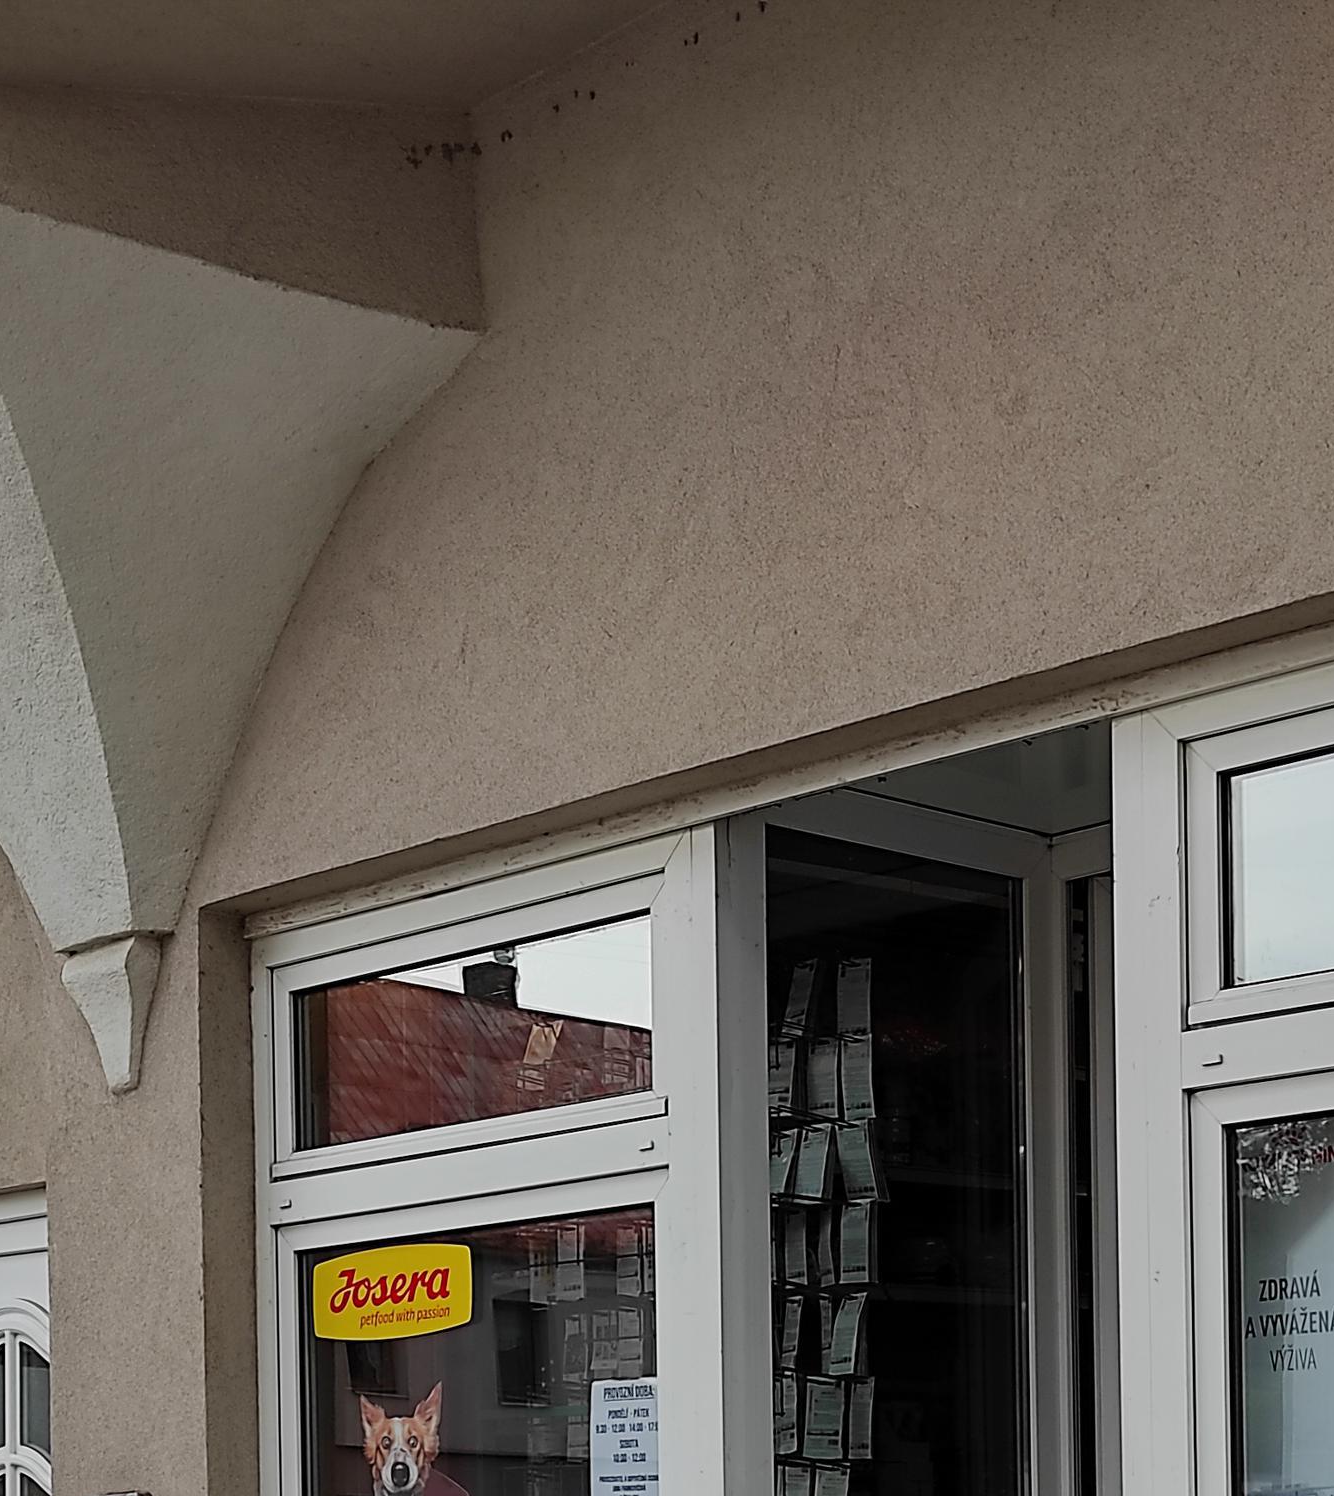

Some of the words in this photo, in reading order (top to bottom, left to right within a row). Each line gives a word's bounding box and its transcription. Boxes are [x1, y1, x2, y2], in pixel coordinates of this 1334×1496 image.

[329, 1268, 450, 1313] Josera
[1259, 1270, 1321, 1302] ZDRAVÁ
[359, 1310, 394, 1329] petfood
[396, 1307, 415, 1322] with
[417, 1304, 450, 1322] passion
[1245, 1316, 1256, 1338] A
[1269, 1344, 1317, 1372] VÝŽIVA
[604, 1384, 634, 1399] PROVOZNÍ
